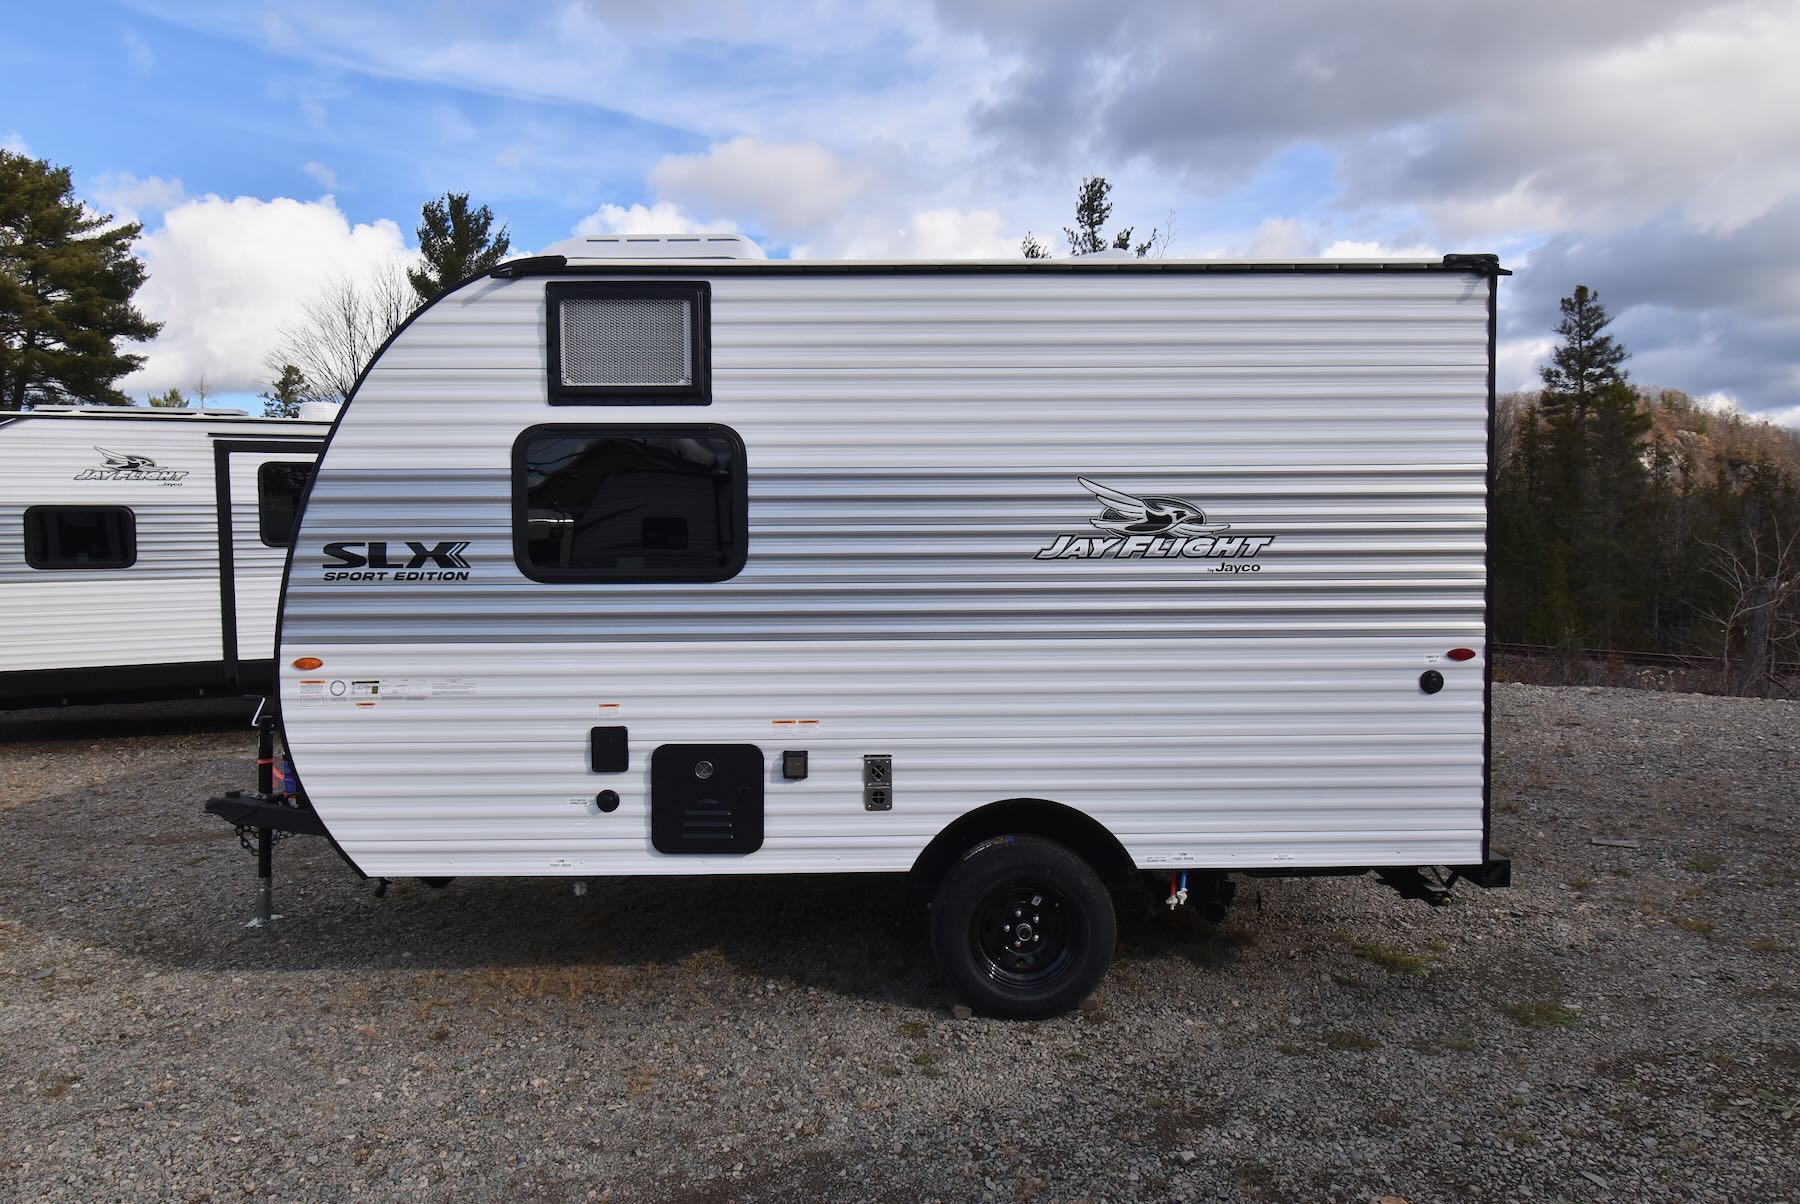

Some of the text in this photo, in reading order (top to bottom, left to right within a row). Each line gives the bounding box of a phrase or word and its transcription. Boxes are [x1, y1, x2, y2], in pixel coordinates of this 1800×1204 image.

[322, 541, 472, 569] SLX
[1215, 562, 1261, 574] Jayco
[323, 571, 470, 582] SPORT EDITION
